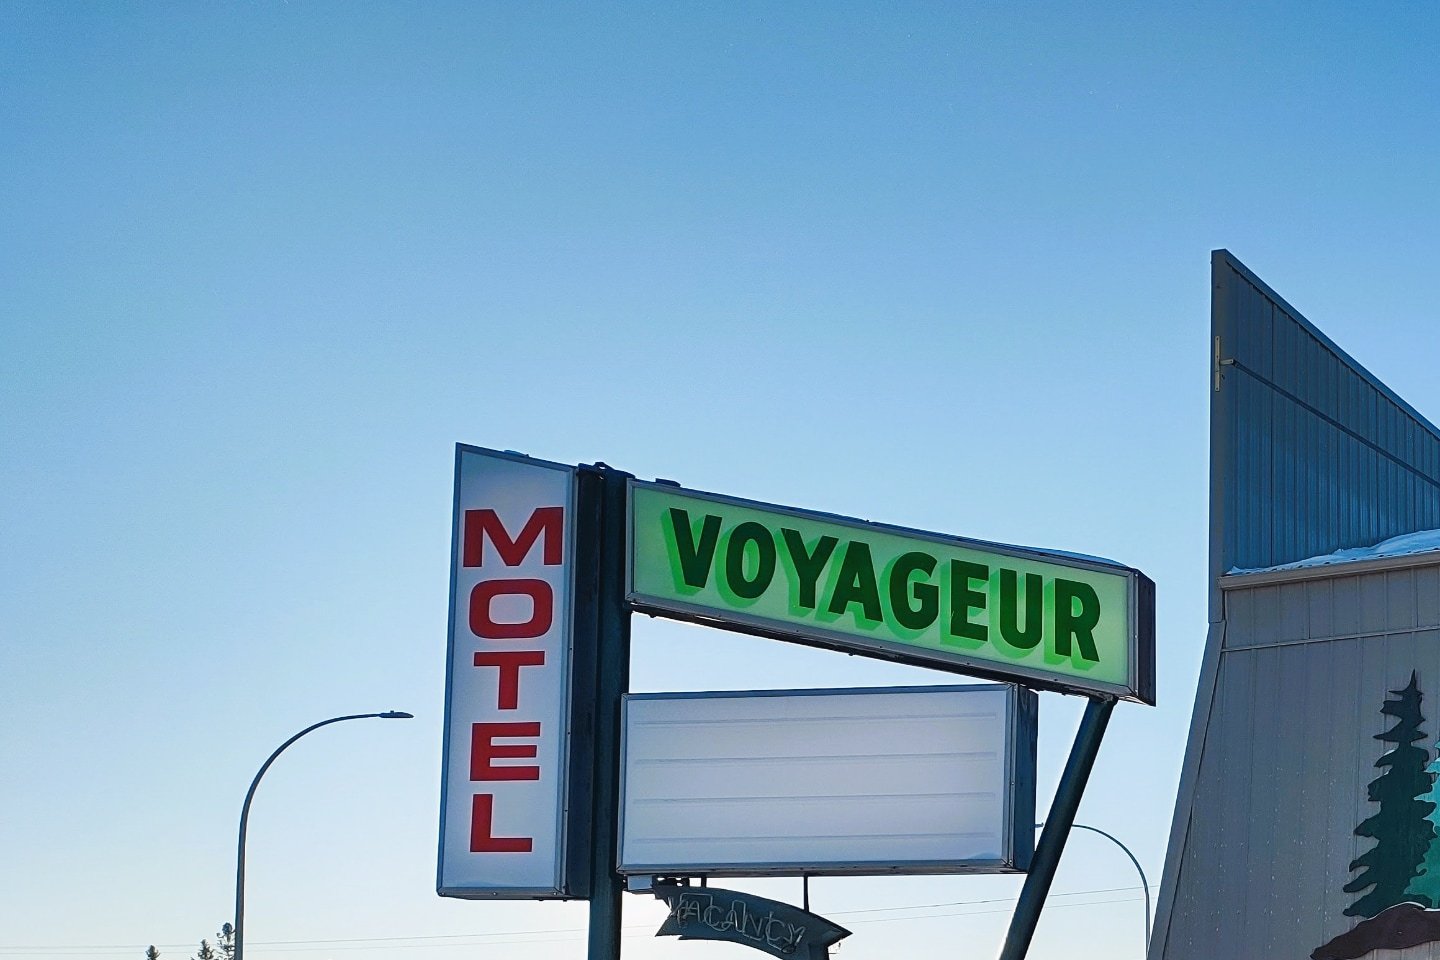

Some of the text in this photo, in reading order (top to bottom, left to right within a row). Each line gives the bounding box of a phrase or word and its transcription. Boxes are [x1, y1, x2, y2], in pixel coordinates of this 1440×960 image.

[663, 507, 1101, 664] VOYAGEUR
[463, 507, 564, 853] MOTEL
[668, 895, 806, 952] VACANCY
